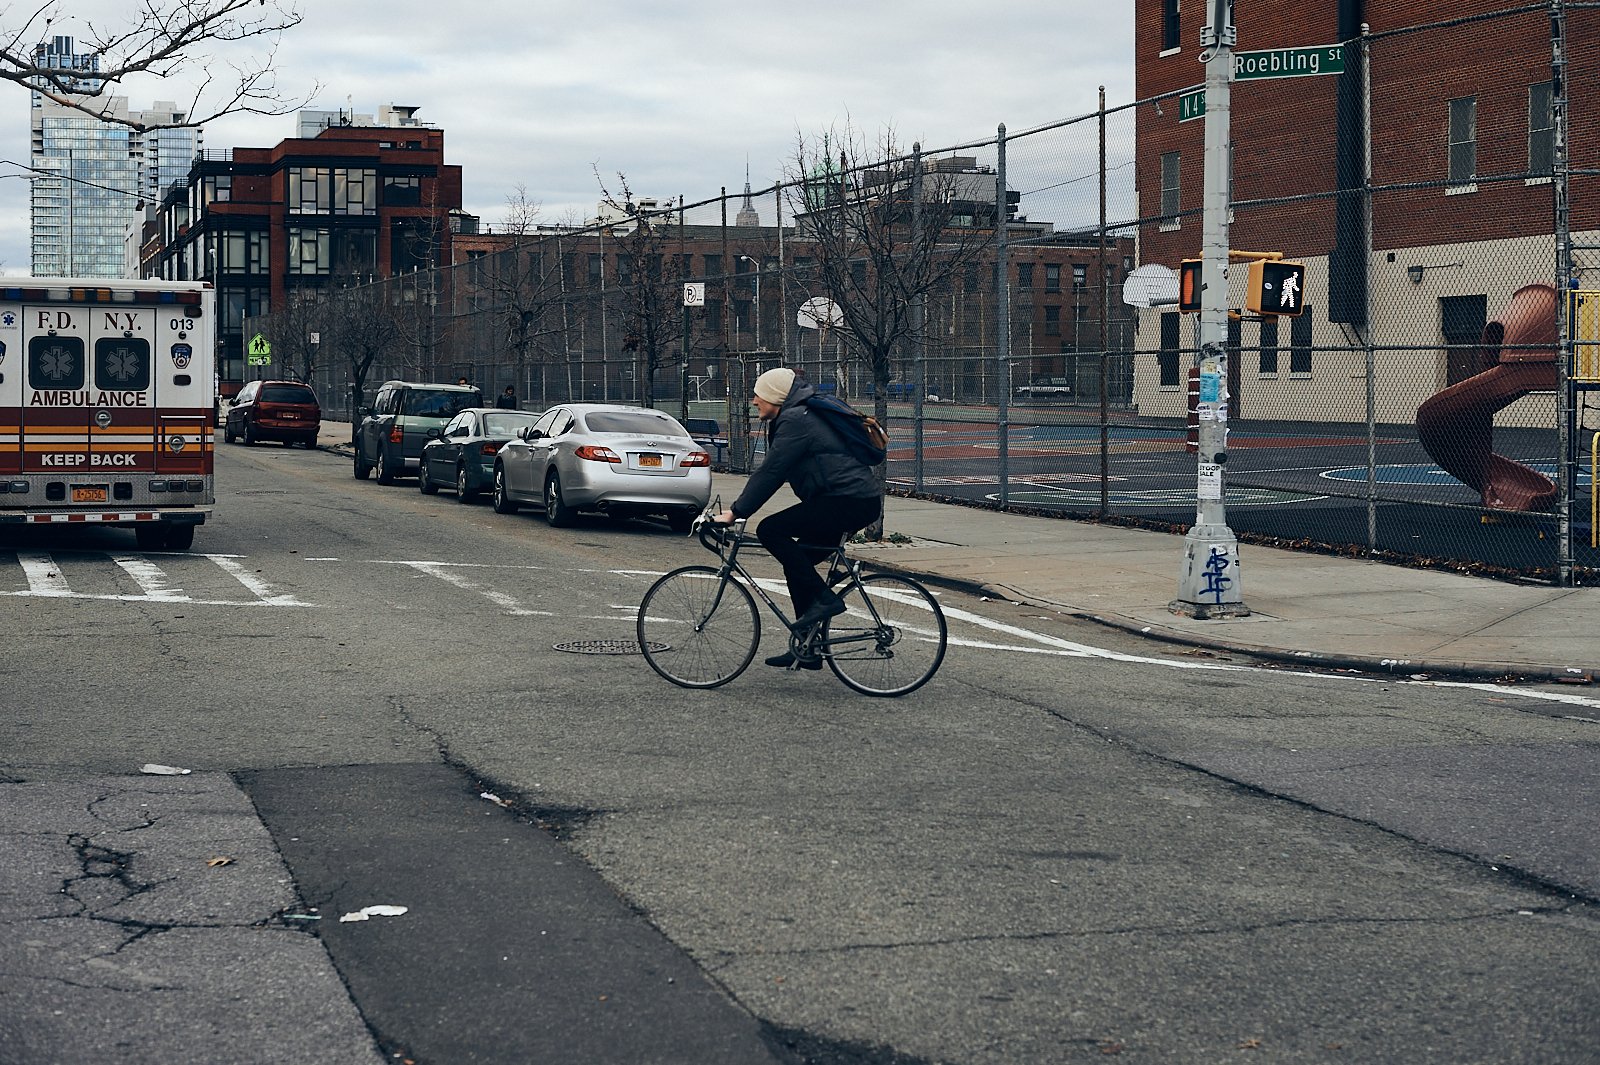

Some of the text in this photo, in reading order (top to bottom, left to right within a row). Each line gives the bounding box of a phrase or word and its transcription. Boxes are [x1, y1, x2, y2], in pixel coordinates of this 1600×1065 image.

[1235, 48, 1341, 73] Roebling St
[1184, 97, 1190, 118] N
[1192, 95, 1198, 115] 4
[170, 318, 194, 331] 013
[30, 391, 147, 407] AMBULANCE
[41, 454, 136, 466] KEEP BACK
